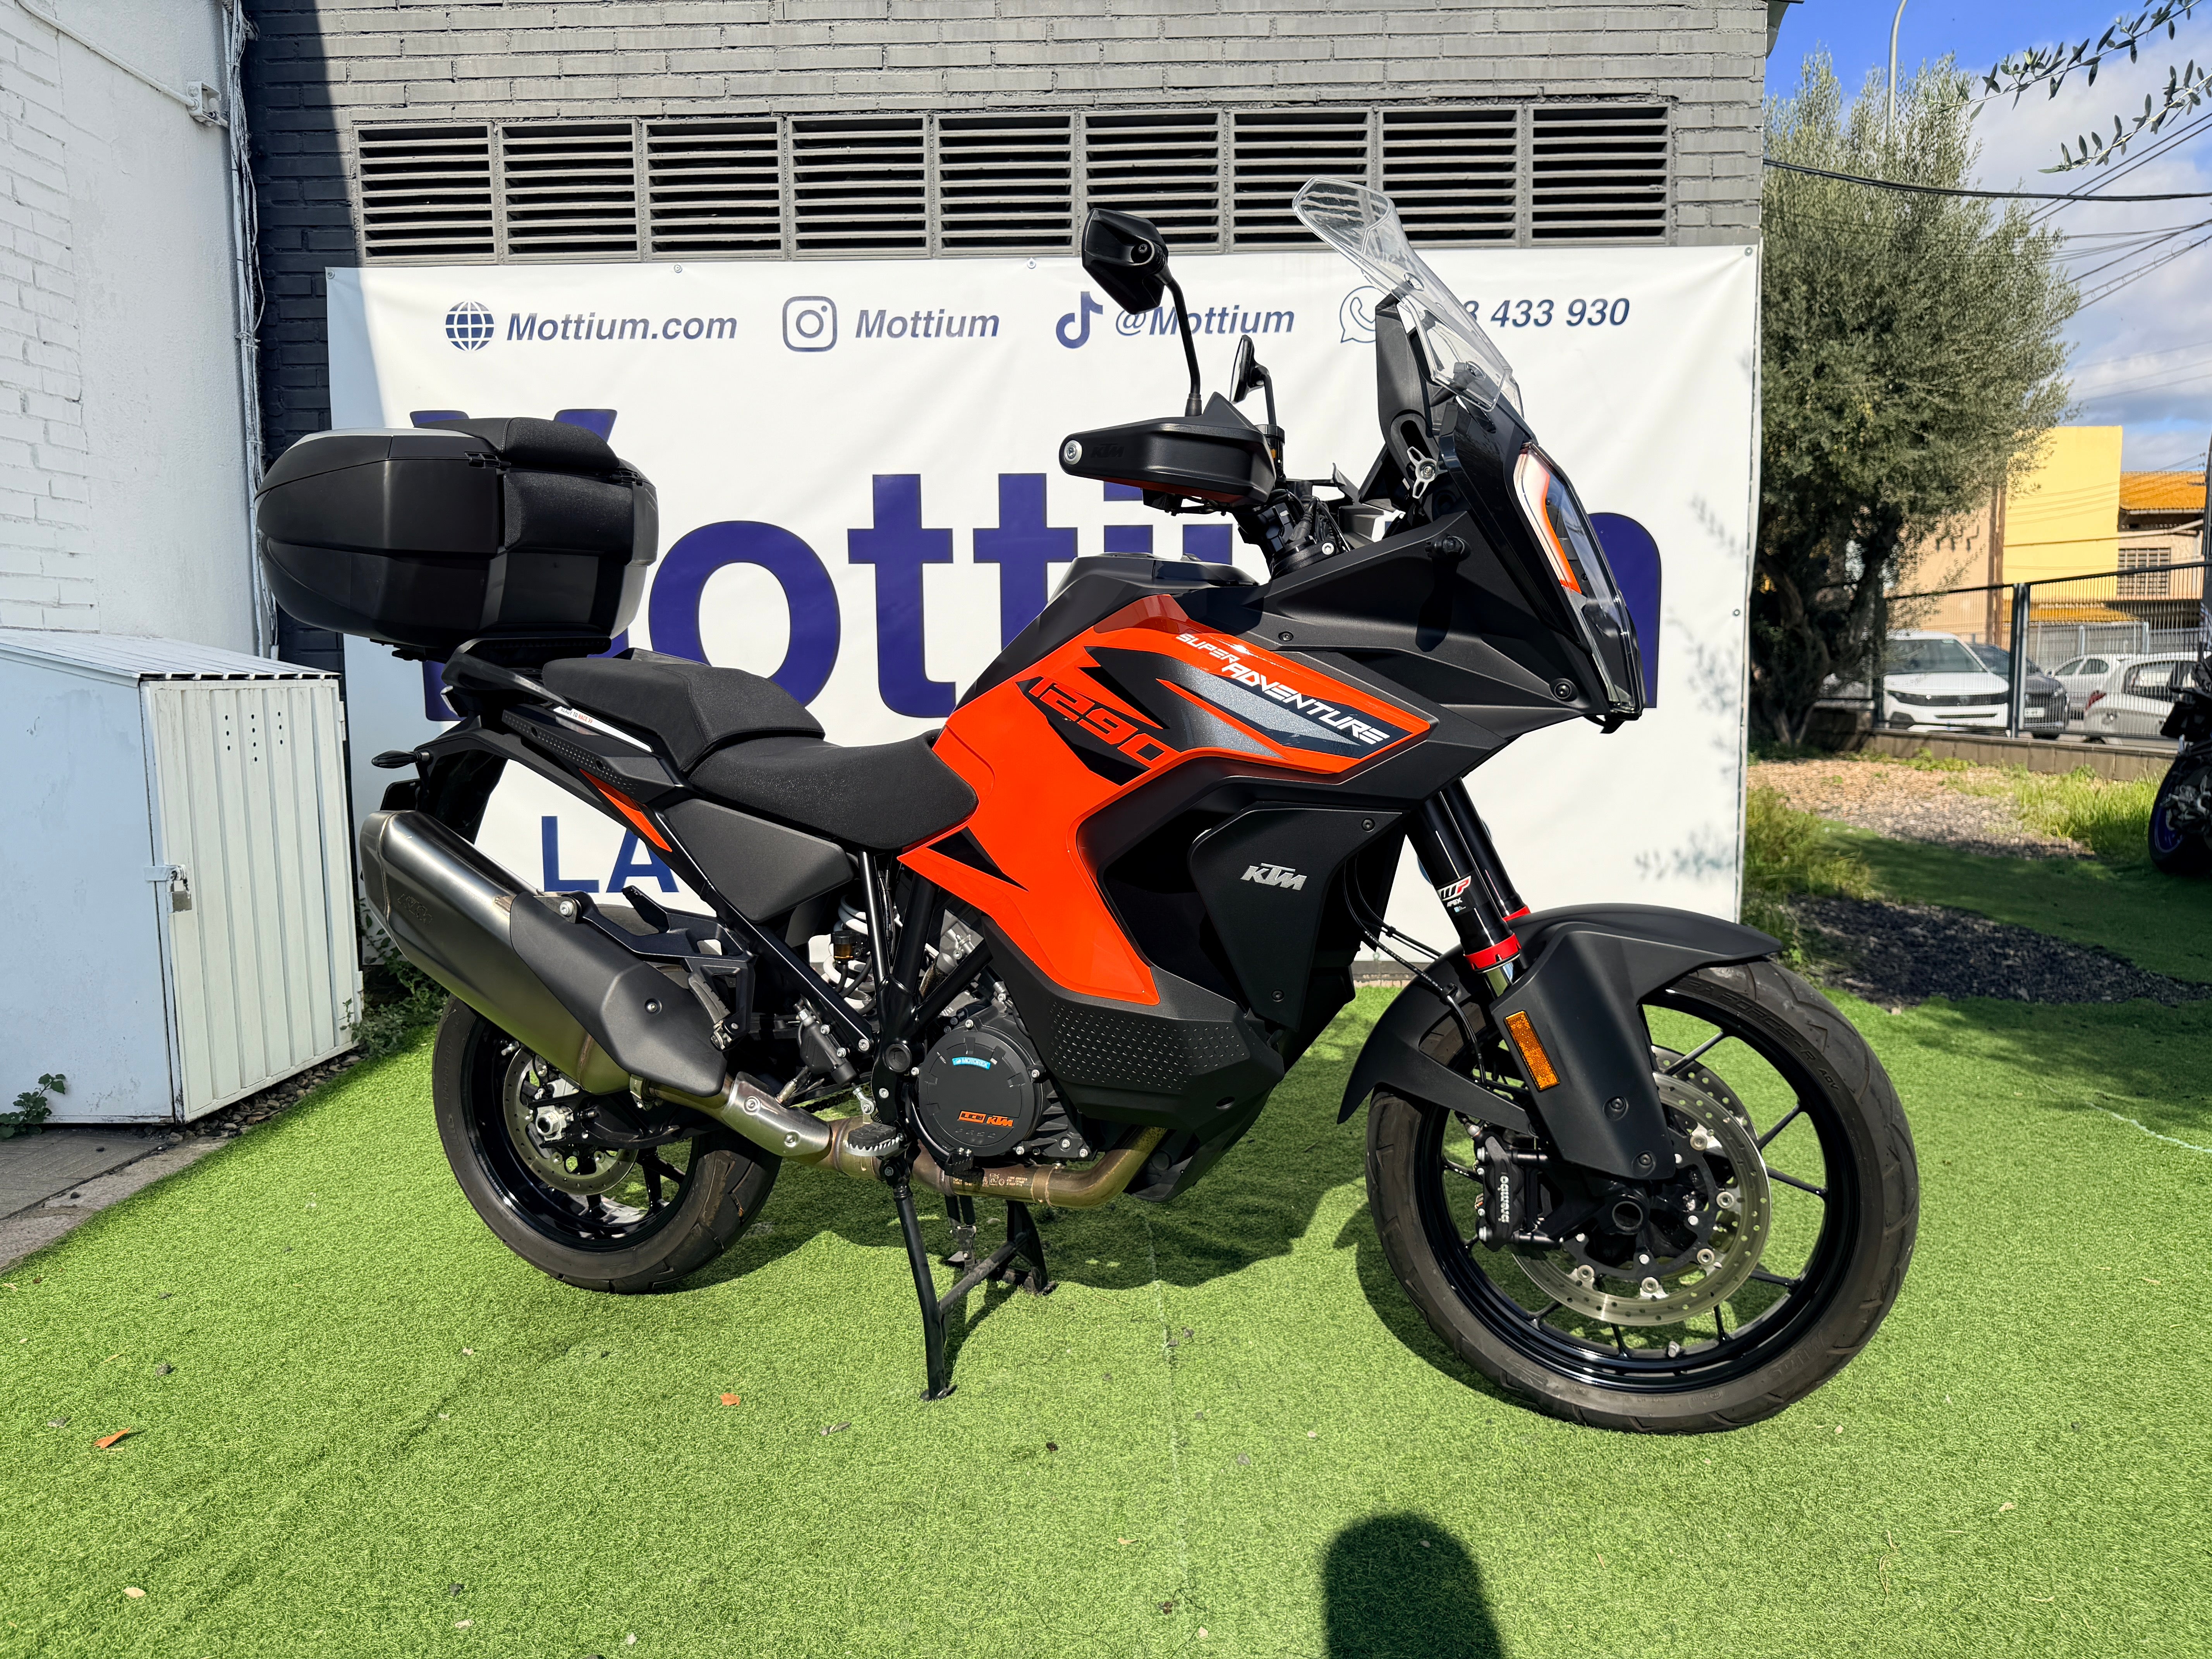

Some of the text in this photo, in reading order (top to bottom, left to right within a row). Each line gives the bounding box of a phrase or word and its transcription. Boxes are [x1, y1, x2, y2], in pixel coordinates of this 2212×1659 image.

[507, 313, 737, 341] Mottium.com
[856, 309, 999, 338] Mottium
[1490, 299, 1554, 328] 433
[1566, 298, 1630, 327] 930
[1091, 443, 1124, 459] KTM
[1176, 633, 1240, 663] SUPER
[1221, 663, 1390, 745] ADVENTURE
[1029, 677, 1180, 769] 1290
[542, 816, 678, 893] LA
[1240, 862, 1307, 891] KTM
[962, 1057, 990, 1069] MOTOREX
[986, 1115, 1013, 1127] KTM
[1497, 1175, 1510, 1223] brembo
